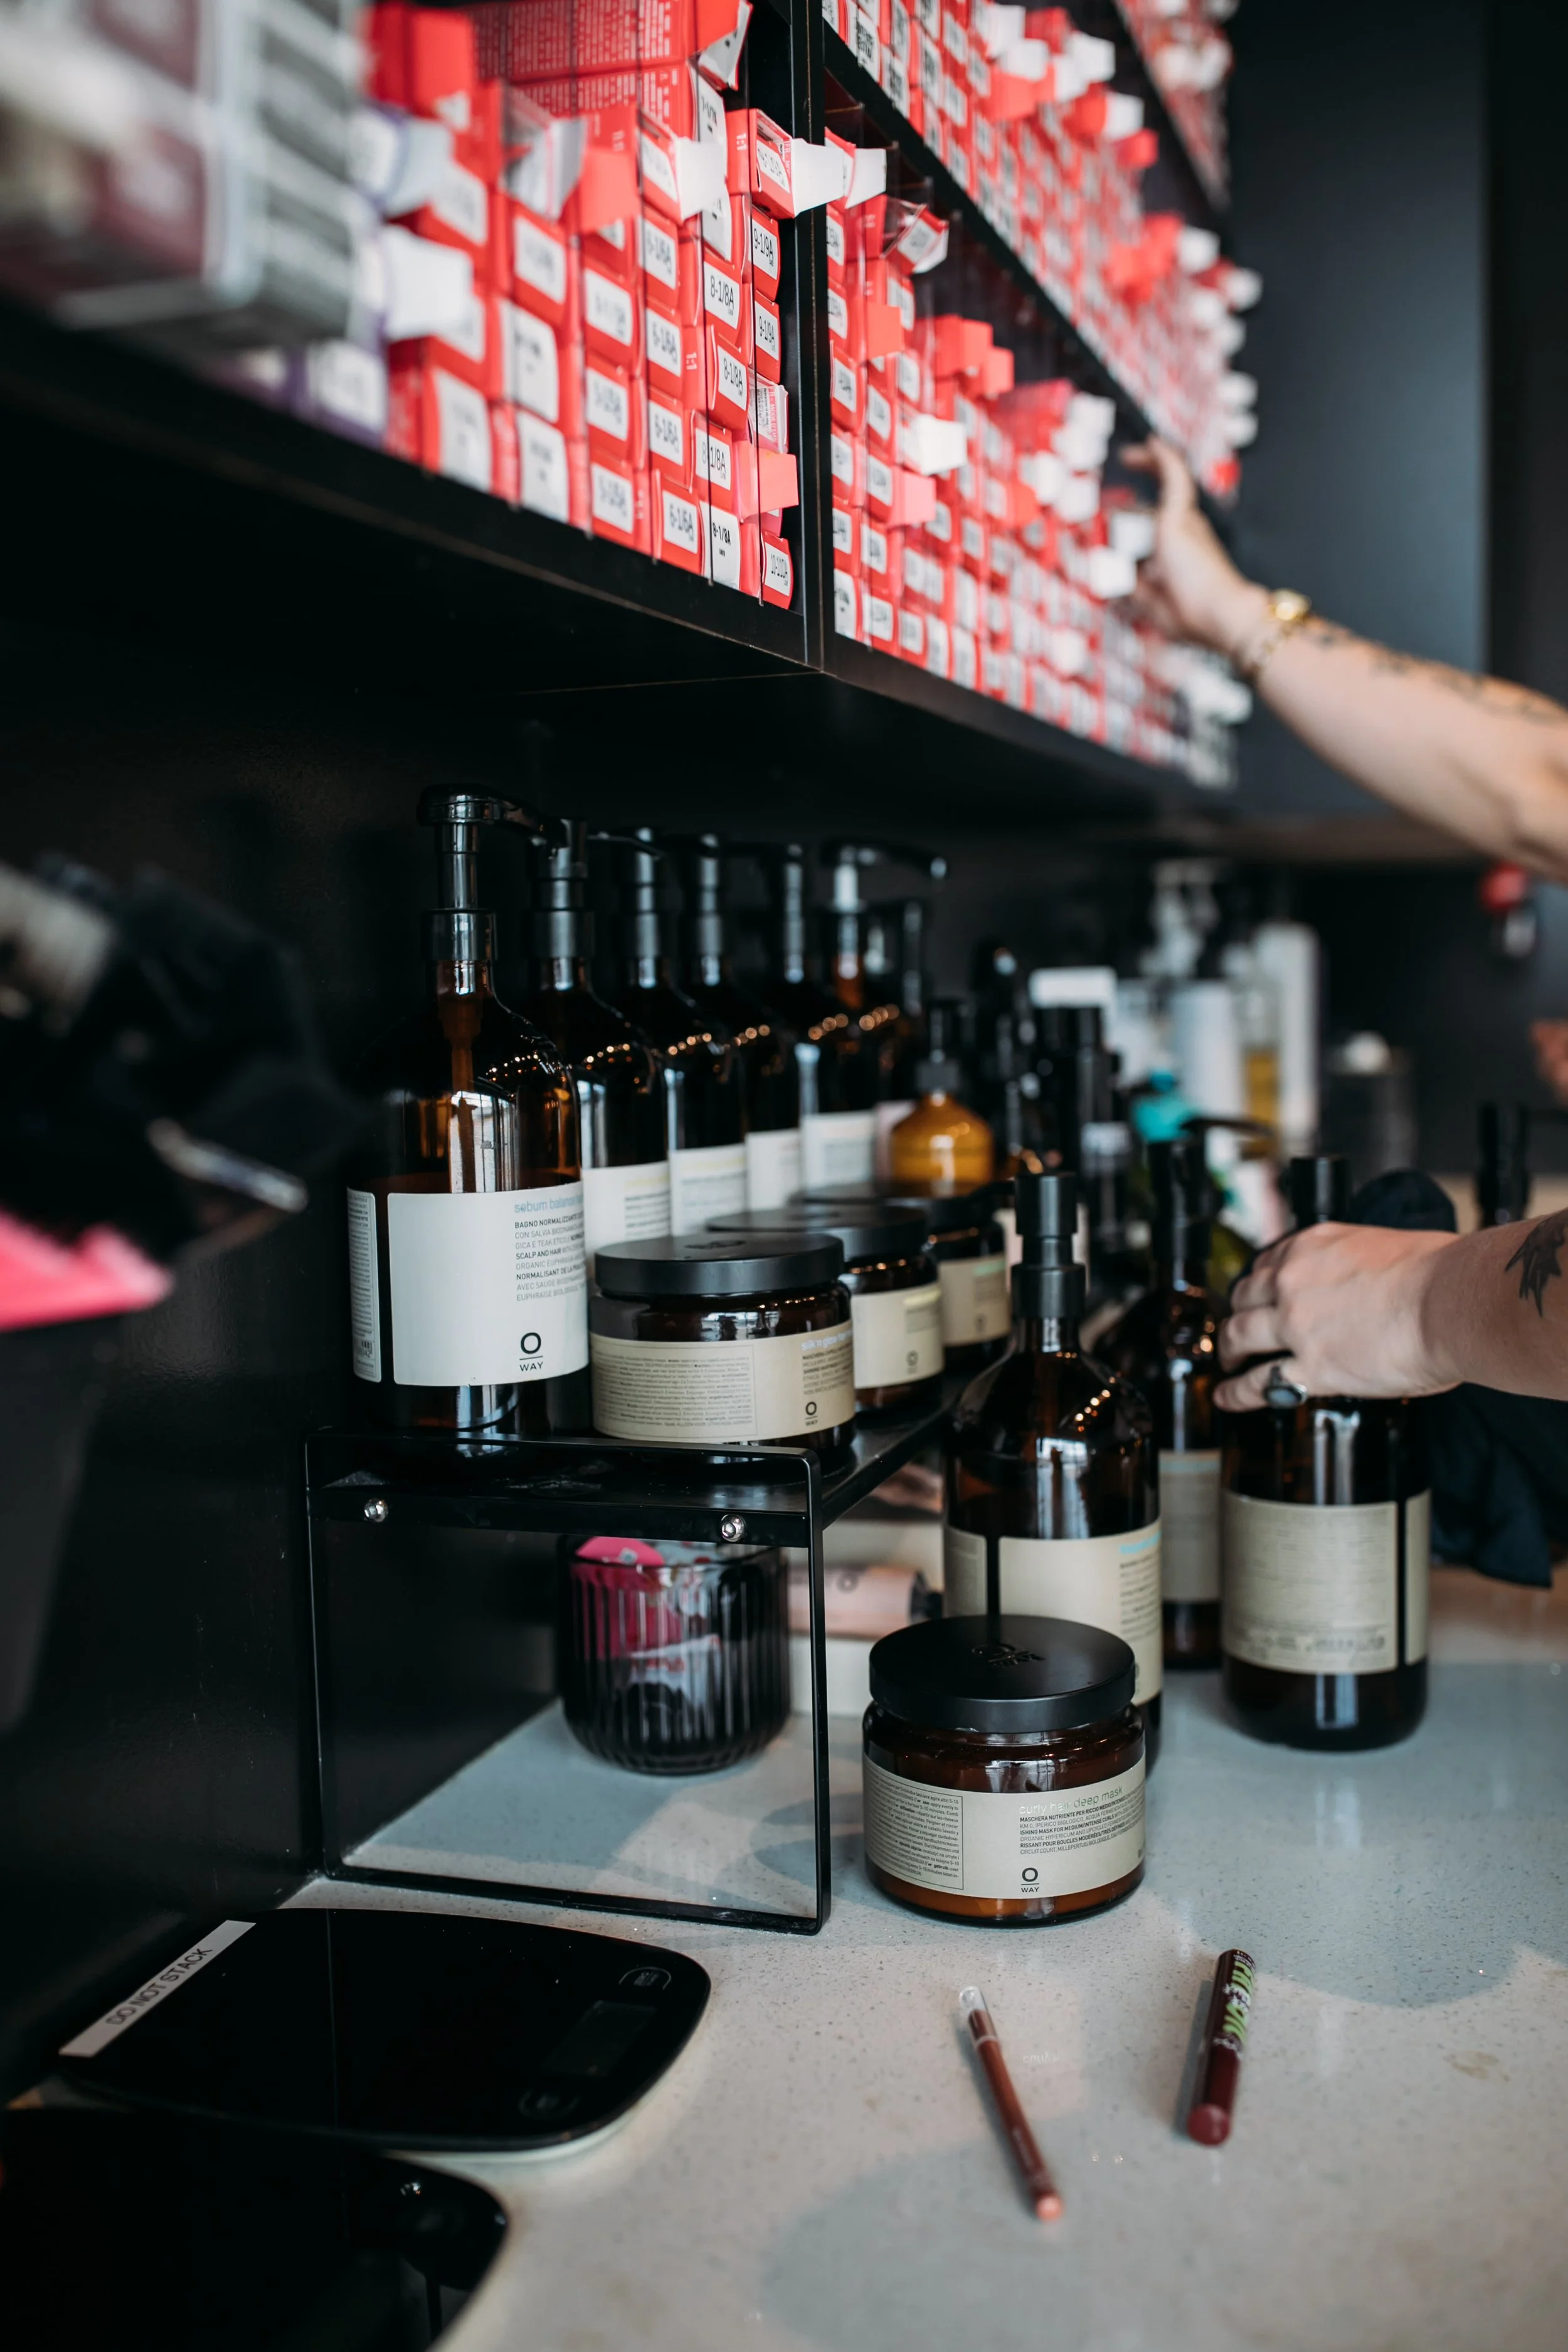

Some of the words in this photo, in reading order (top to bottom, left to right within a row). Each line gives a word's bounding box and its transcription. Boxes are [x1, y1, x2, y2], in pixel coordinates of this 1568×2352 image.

[736, 132, 747, 151] 1:1
[754, 228, 773, 259] 9-1/9A
[710, 275, 734, 309] 8-1/8A
[759, 316, 775, 344] 9-1/9A
[723, 358, 743, 389] 8-1/8A
[702, 442, 726, 470] 81/8A
[669, 503, 693, 536] 6-1/6A
[712, 522, 731, 546] 8-1/8A
[514, 1199, 548, 1213] sebum
[514, 1221, 538, 1229] BAGNO
[514, 1231, 529, 1239] CON
[531, 1229, 551, 1237] SALVIA
[516, 1251, 536, 1260] SCALP
[537, 1249, 549, 1258] AND
[516, 1259, 546, 1271] ORGANIC
[516, 1268, 559, 1281] NORMALISANT
[517, 1283, 534, 1291] AVEC
[520, 1332, 541, 1354] O
[519, 1361, 543, 1372] WAY
[805, 1401, 817, 1416] O
[1019, 1803, 1047, 1816] curly
[1074, 1795, 1099, 1808] deep
[1101, 1786, 1123, 1801] mask
[1049, 1812, 1076, 1820] NUTRIENTE
[1064, 1817, 1102, 1831] MEDIUM/INTENSE
[1102, 1814, 1115, 1822] CURLS
[1045, 1832, 1075, 1840] HYPERICUM
[1086, 1823, 1107, 1833] UPCYCLED
[1057, 1837, 1078, 1845] BOUCLES
[1057, 1841, 1088, 1851] MILLEPERTUIS
[1022, 1867, 1038, 1882] O
[105, 2006, 137, 2025] DO
[129, 1982, 167, 2007] NOT
[159, 1948, 213, 1982] STACK
